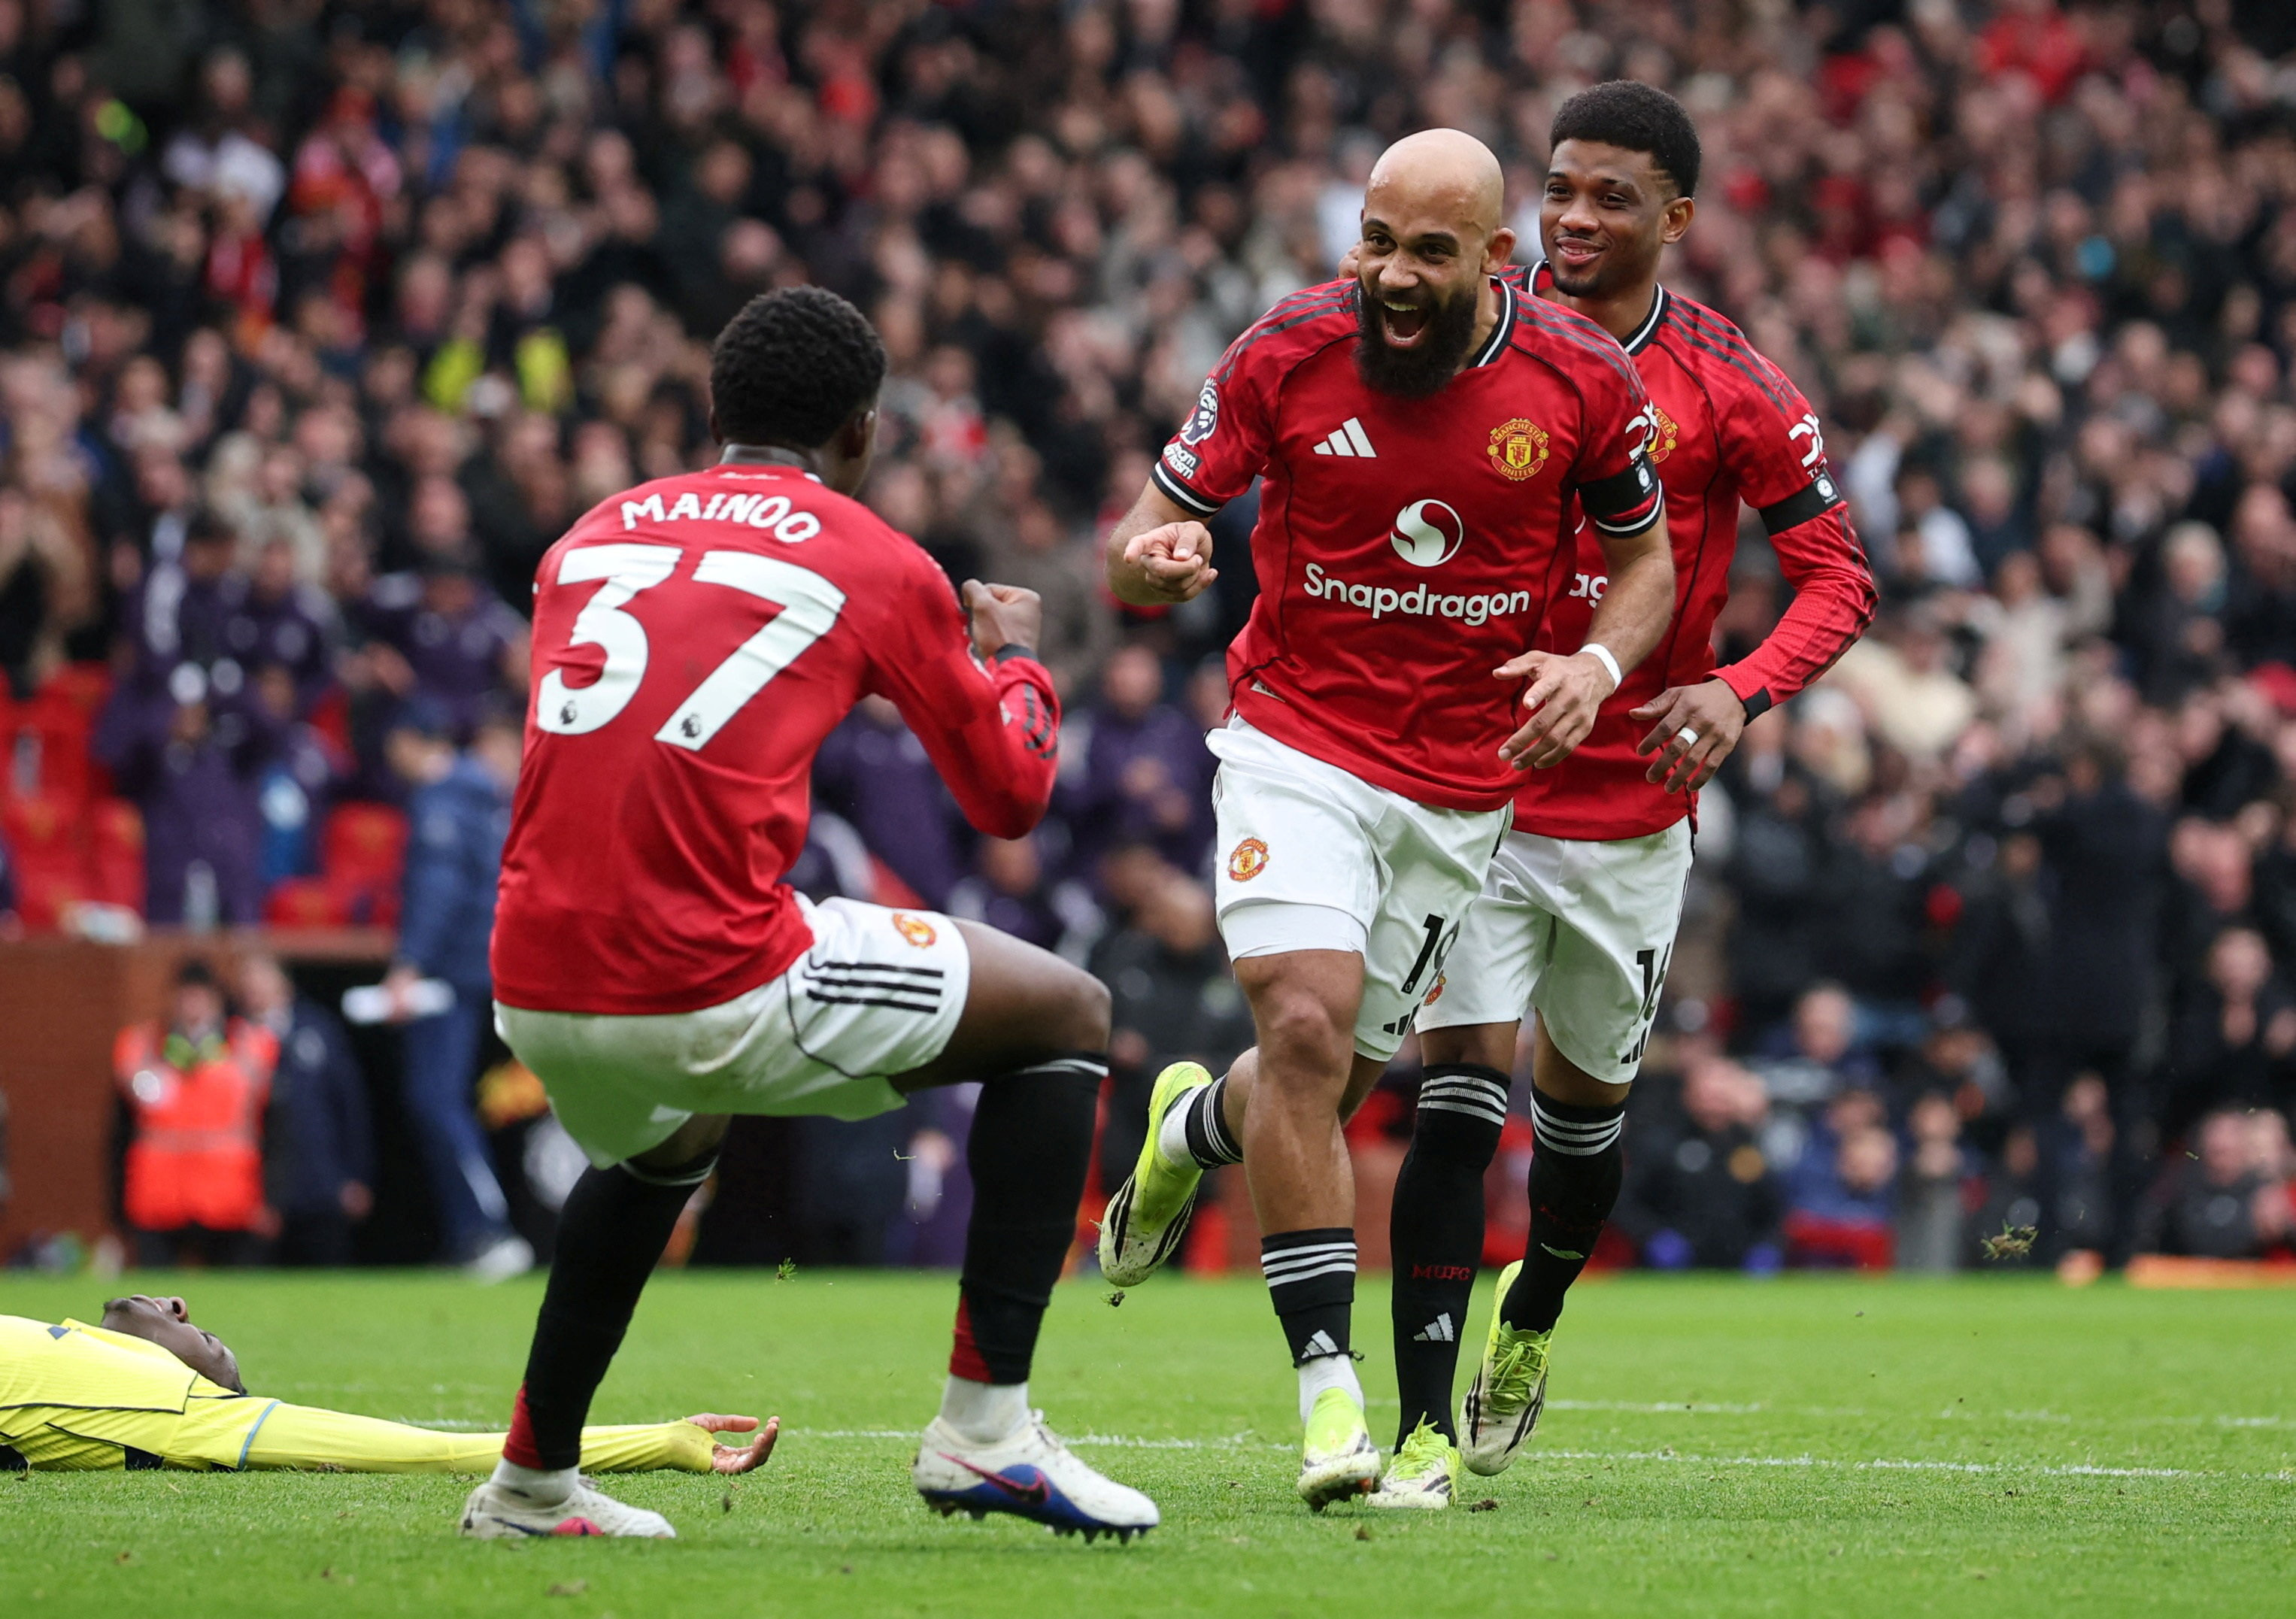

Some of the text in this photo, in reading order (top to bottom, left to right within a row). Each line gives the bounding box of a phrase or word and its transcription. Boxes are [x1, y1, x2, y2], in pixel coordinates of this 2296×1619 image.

[1494, 423, 1545, 444] MANCHESTER
[1500, 465, 1535, 478] UNITED
[621, 493, 821, 543] MAINOO
[1303, 562, 1530, 626] Snapdragon
[537, 543, 848, 751] 37
[1411, 1264, 1472, 1281] MUFC
